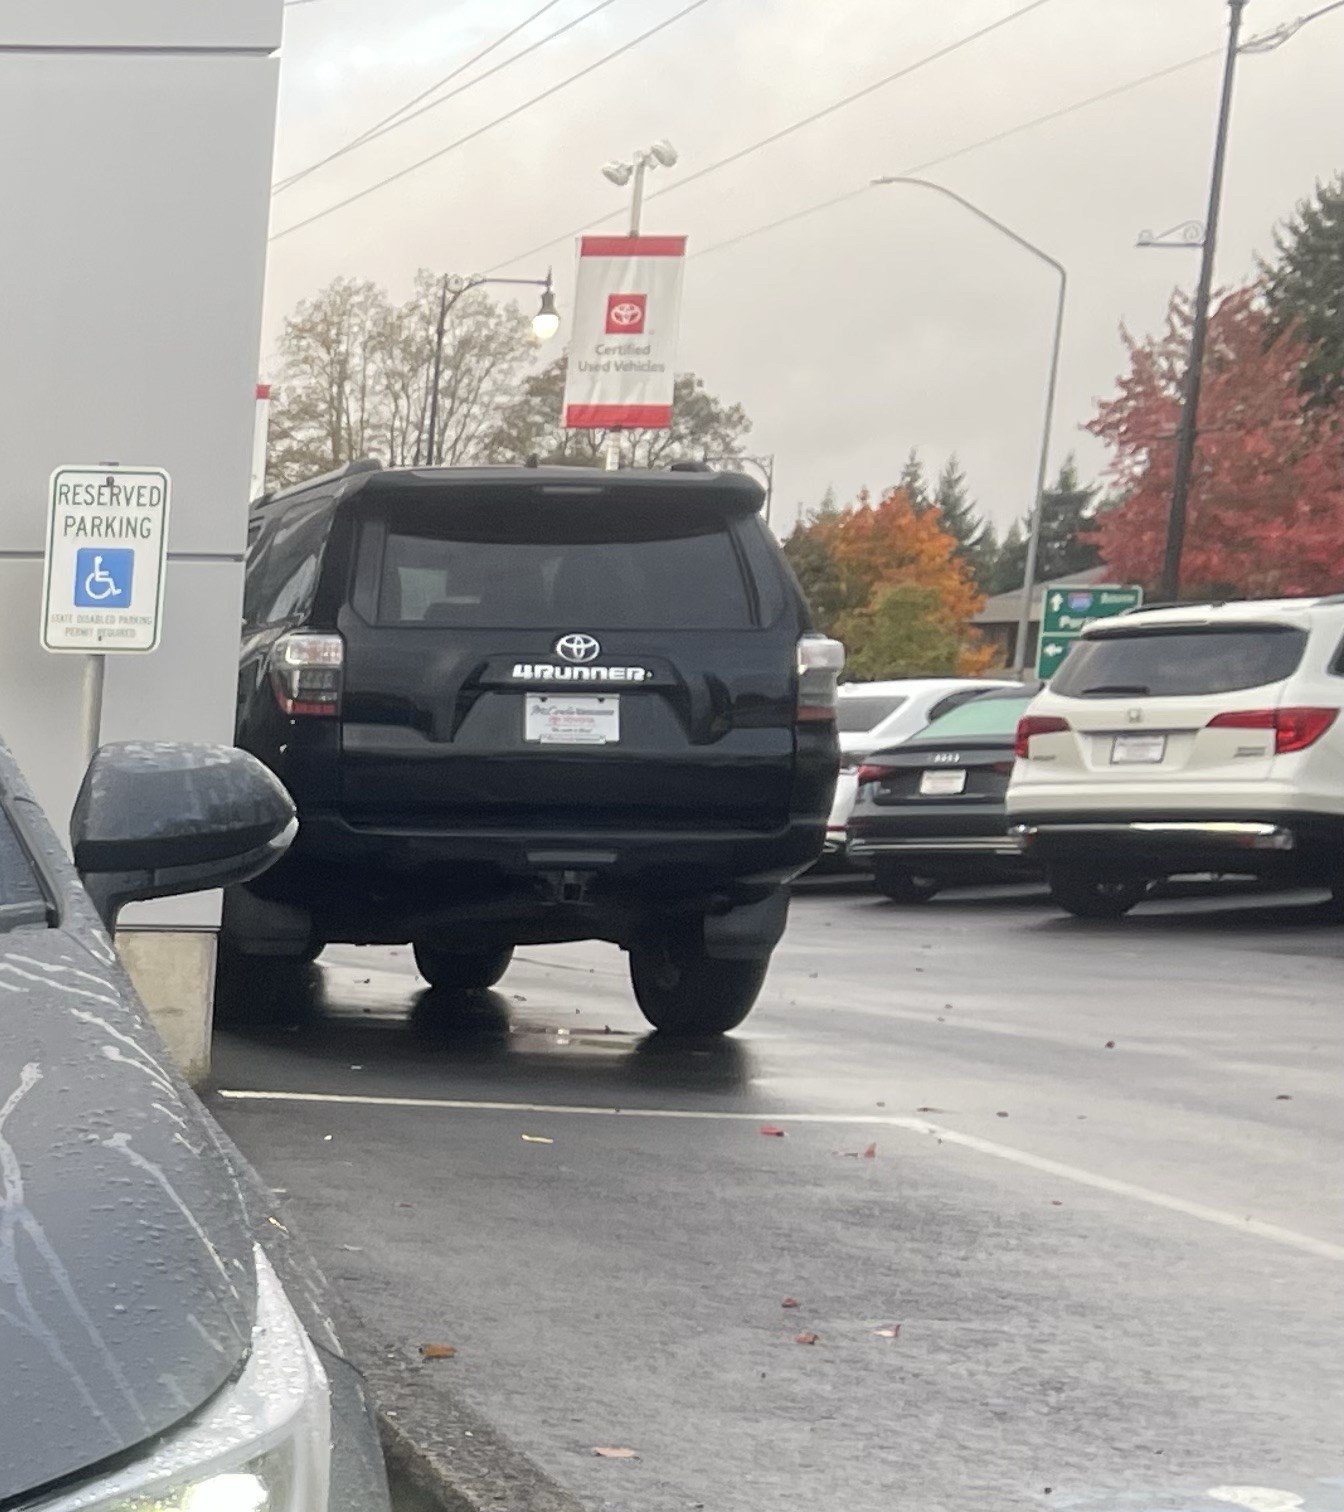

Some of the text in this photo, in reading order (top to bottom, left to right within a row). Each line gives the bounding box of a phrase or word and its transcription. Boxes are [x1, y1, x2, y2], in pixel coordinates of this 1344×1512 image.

[595, 344, 651, 356] Certified
[578, 360, 665, 373] Used Vehicles
[58, 483, 161, 507] RESERVED
[63, 515, 152, 539] PARKING
[512, 664, 646, 681] 4RUNNER
